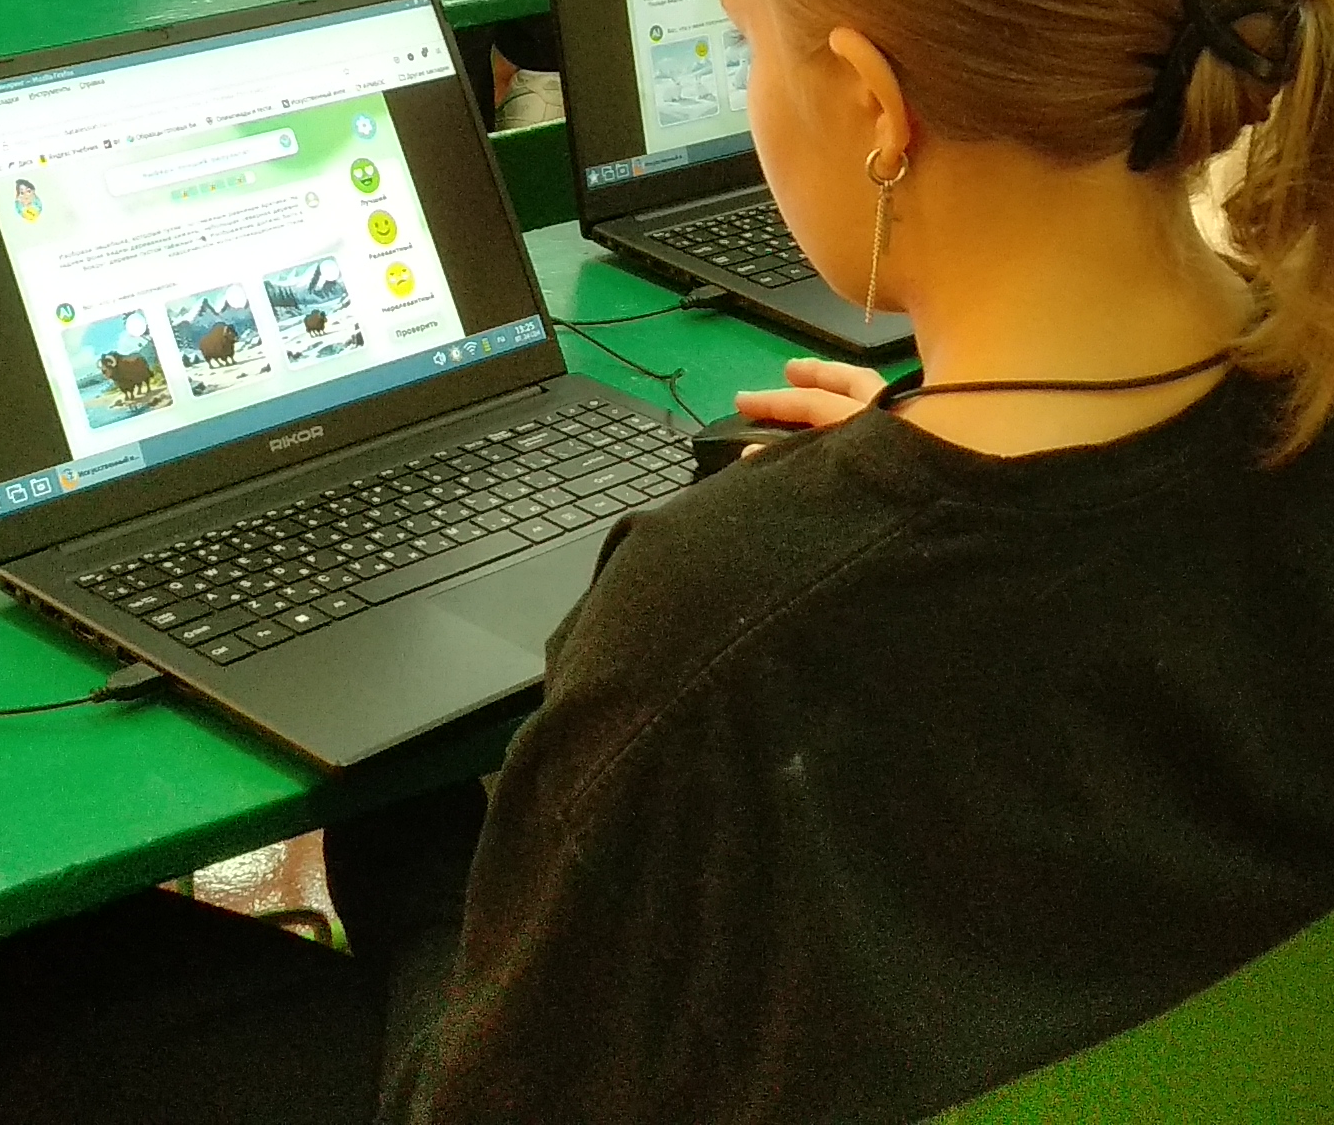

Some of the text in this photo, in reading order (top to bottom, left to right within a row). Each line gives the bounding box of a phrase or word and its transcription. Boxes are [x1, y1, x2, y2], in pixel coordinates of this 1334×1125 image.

[28, 86, 72, 101] Инструменты
[79, 78, 106, 91] Справка
[290, 90, 333, 106] Искусственный
[18, 158, 34, 168] Диск
[360, 194, 388, 207] Лучший
[368, 242, 414, 261] Релевантный
[395, 319, 439, 339] Проверить
[514, 321, 535, 335] 13:25
[268, 424, 325, 452] RIKOR
